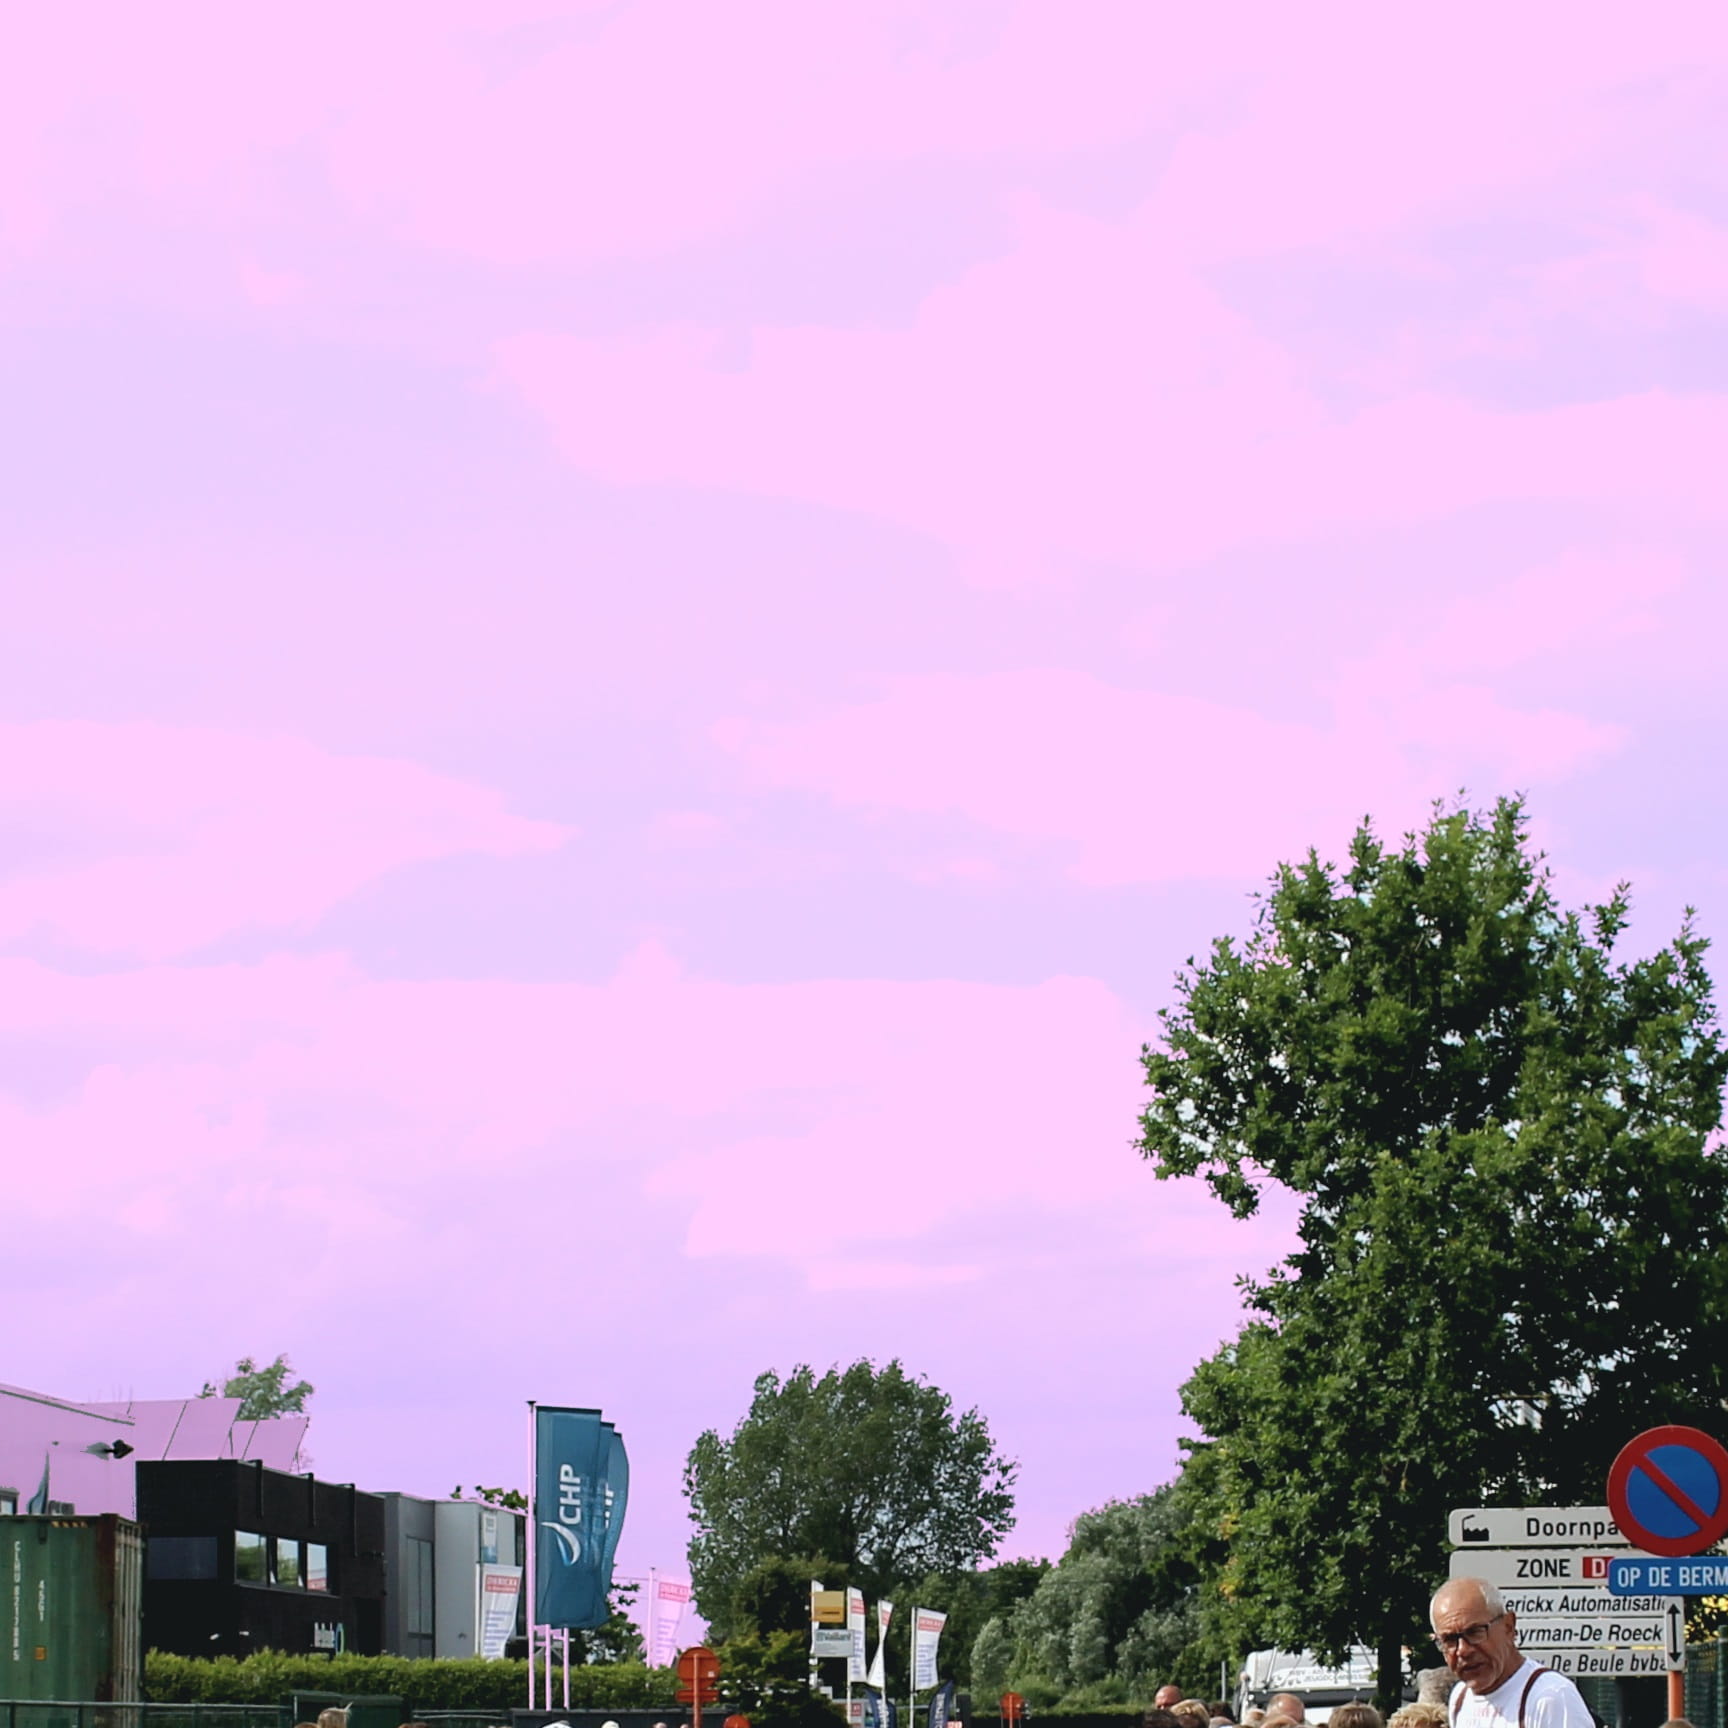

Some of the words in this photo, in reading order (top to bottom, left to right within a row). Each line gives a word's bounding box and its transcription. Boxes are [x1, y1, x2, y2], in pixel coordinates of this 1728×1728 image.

[559, 1463, 582, 1525] CHP
[1526, 1518, 1618, 1541] Doornpa
[1516, 1558, 1571, 1578] ZONE
[1617, 1567, 1641, 1588] OP
[1648, 1566, 1672, 1587] DE
[1502, 1594, 1554, 1613] erickx
[1558, 1593, 1666, 1613] Automatisati
[1607, 1623, 1663, 1642] Roeck
[1551, 1654, 1572, 1673] De
[1577, 1655, 1624, 1673] Beule
[1629, 1652, 1667, 1673] bvba
